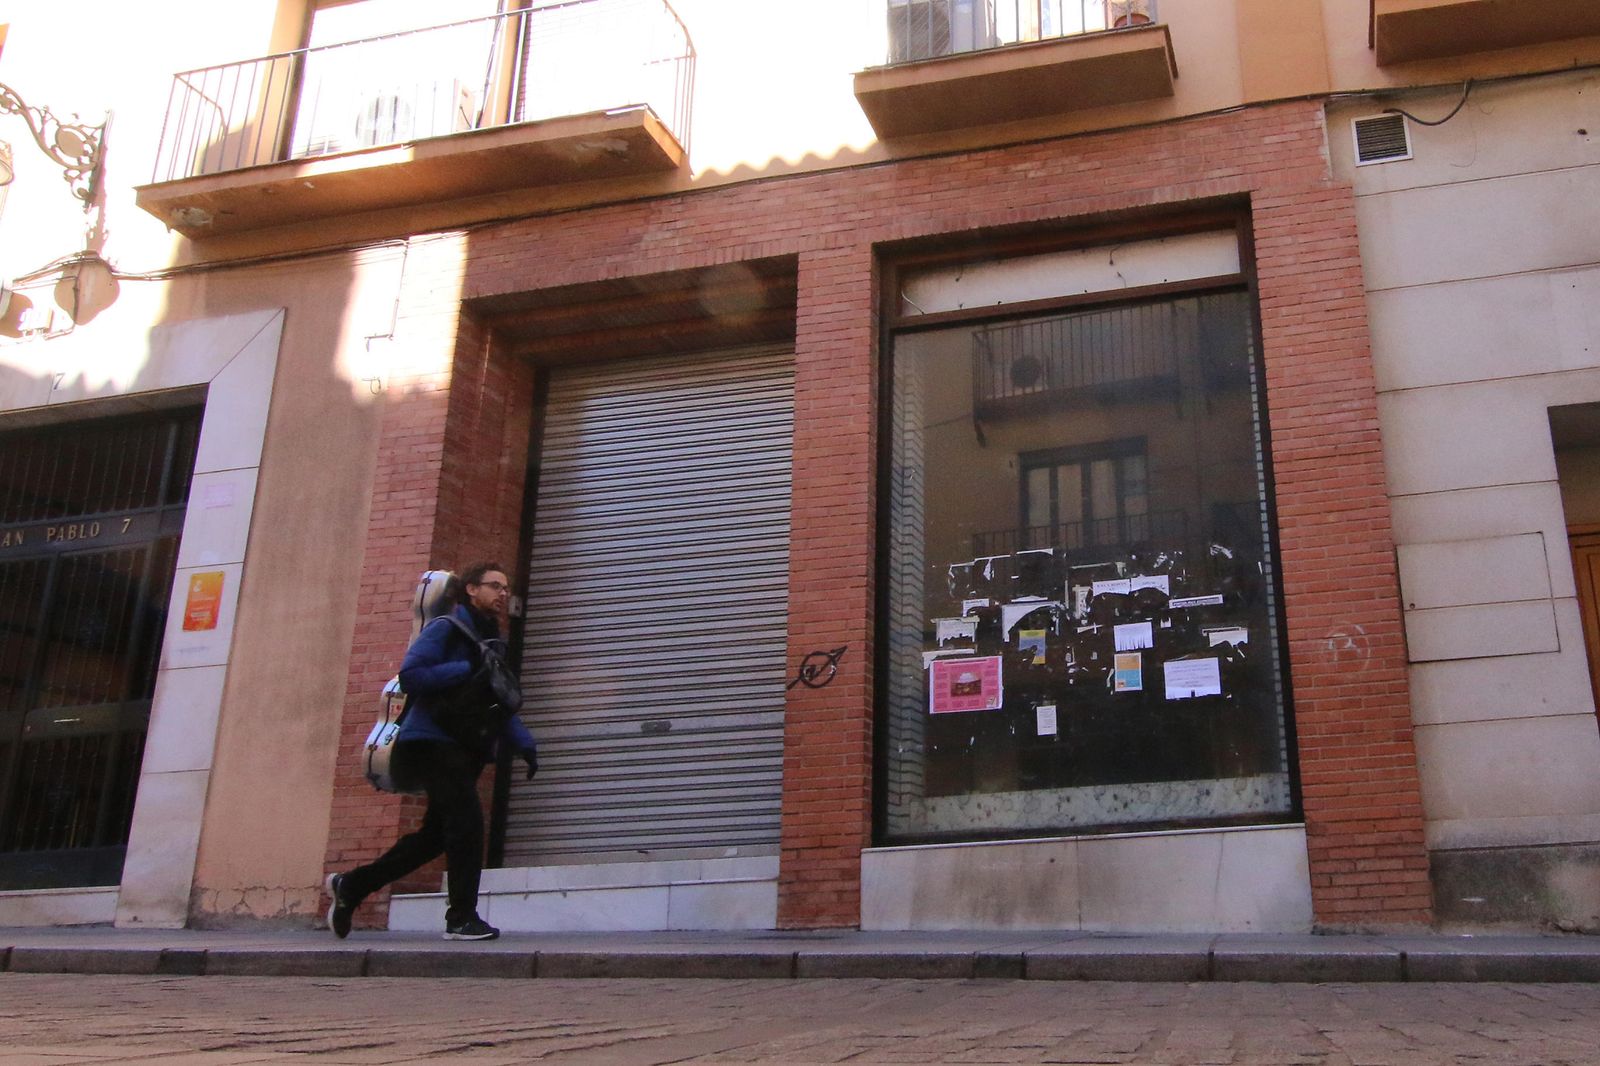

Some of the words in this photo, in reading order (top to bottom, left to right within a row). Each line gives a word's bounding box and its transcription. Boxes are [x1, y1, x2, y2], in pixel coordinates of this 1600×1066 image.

[53, 373, 65, 390] 7
[46, 521, 100, 542] PABLO
[121, 518, 131, 534] 7
